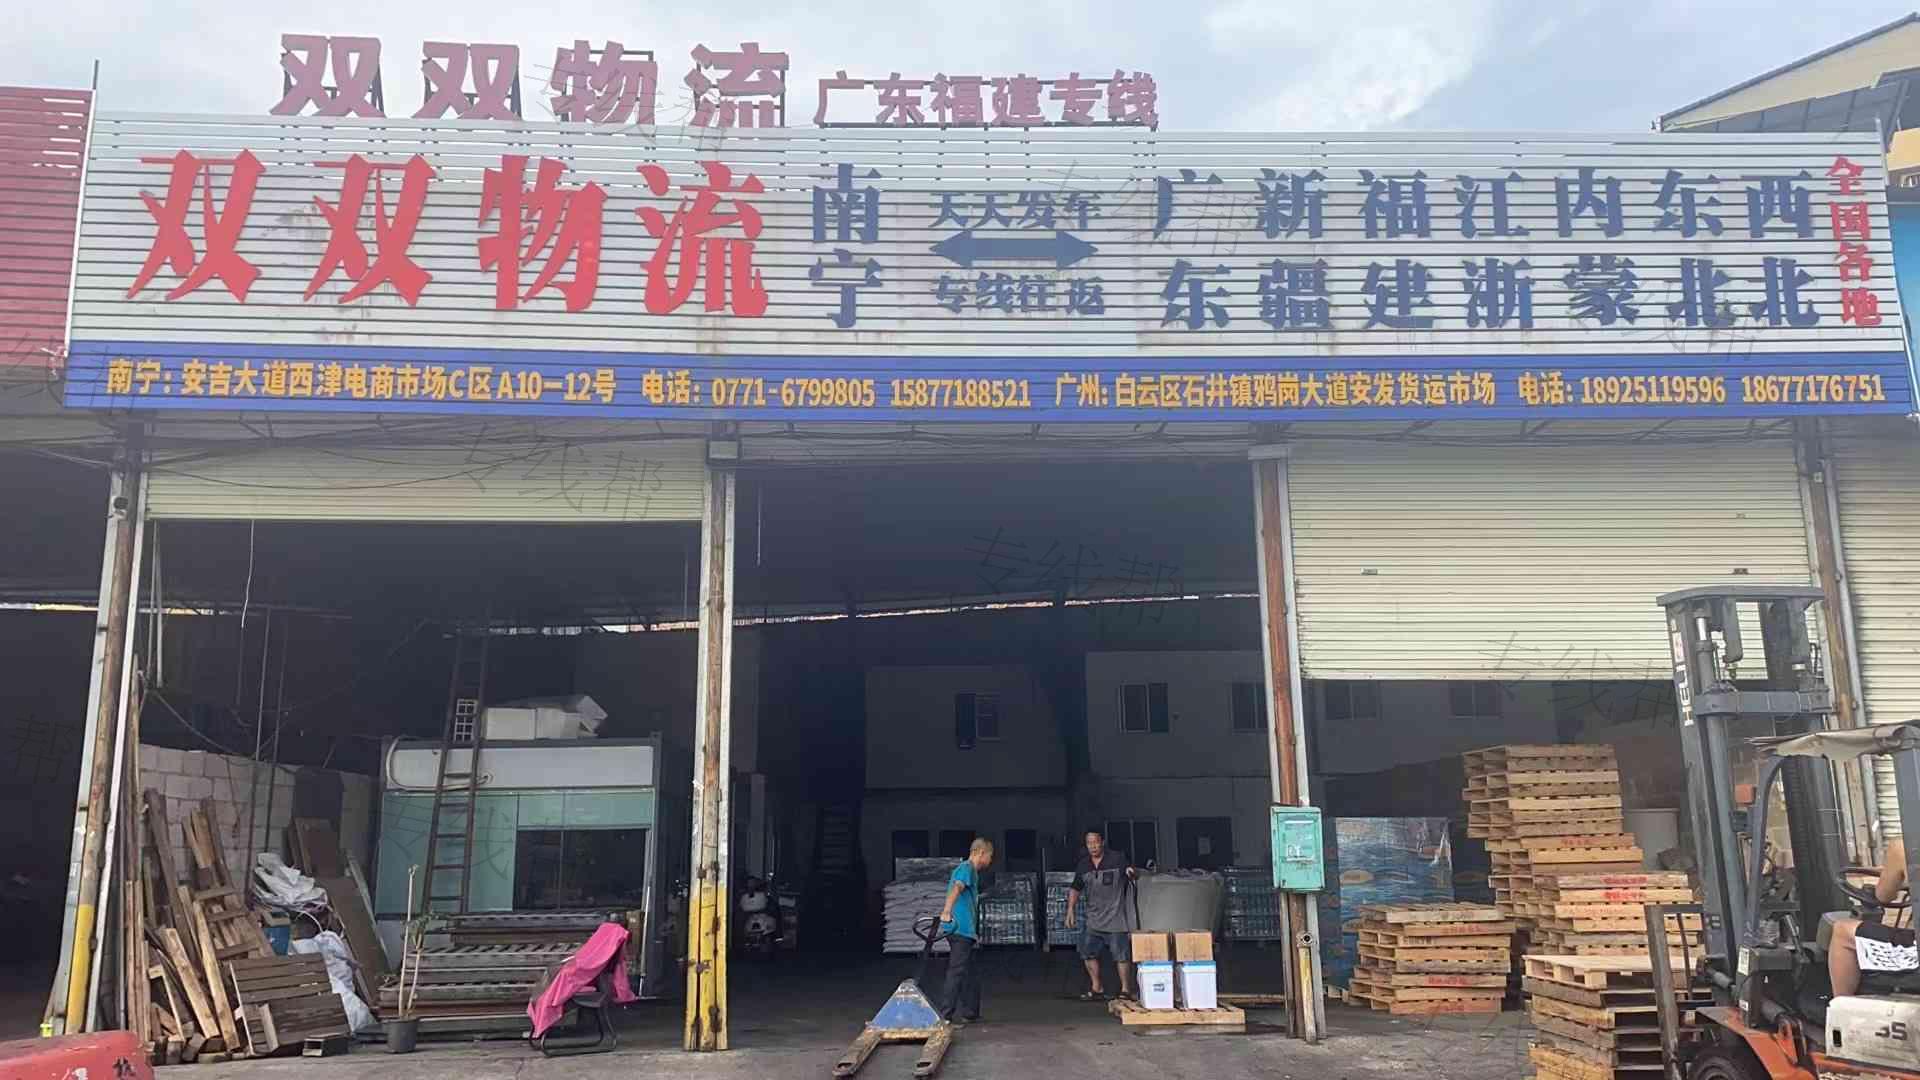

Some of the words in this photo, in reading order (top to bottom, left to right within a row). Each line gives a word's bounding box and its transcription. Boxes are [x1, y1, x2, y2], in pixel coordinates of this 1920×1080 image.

[269, 33, 790, 128] 双双物流
[814, 69, 1157, 127] 广东福建专线
[126, 149, 769, 317] 双双物流
[808, 163, 884, 328] 南宁
[928, 191, 1102, 230] 天天发车
[1826, 154, 1883, 327] 全国各地
[930, 271, 1105, 315] 专线往返
[890, 378, 1031, 408] 15877188521
[1741, 374, 1886, 402] 18677176751
